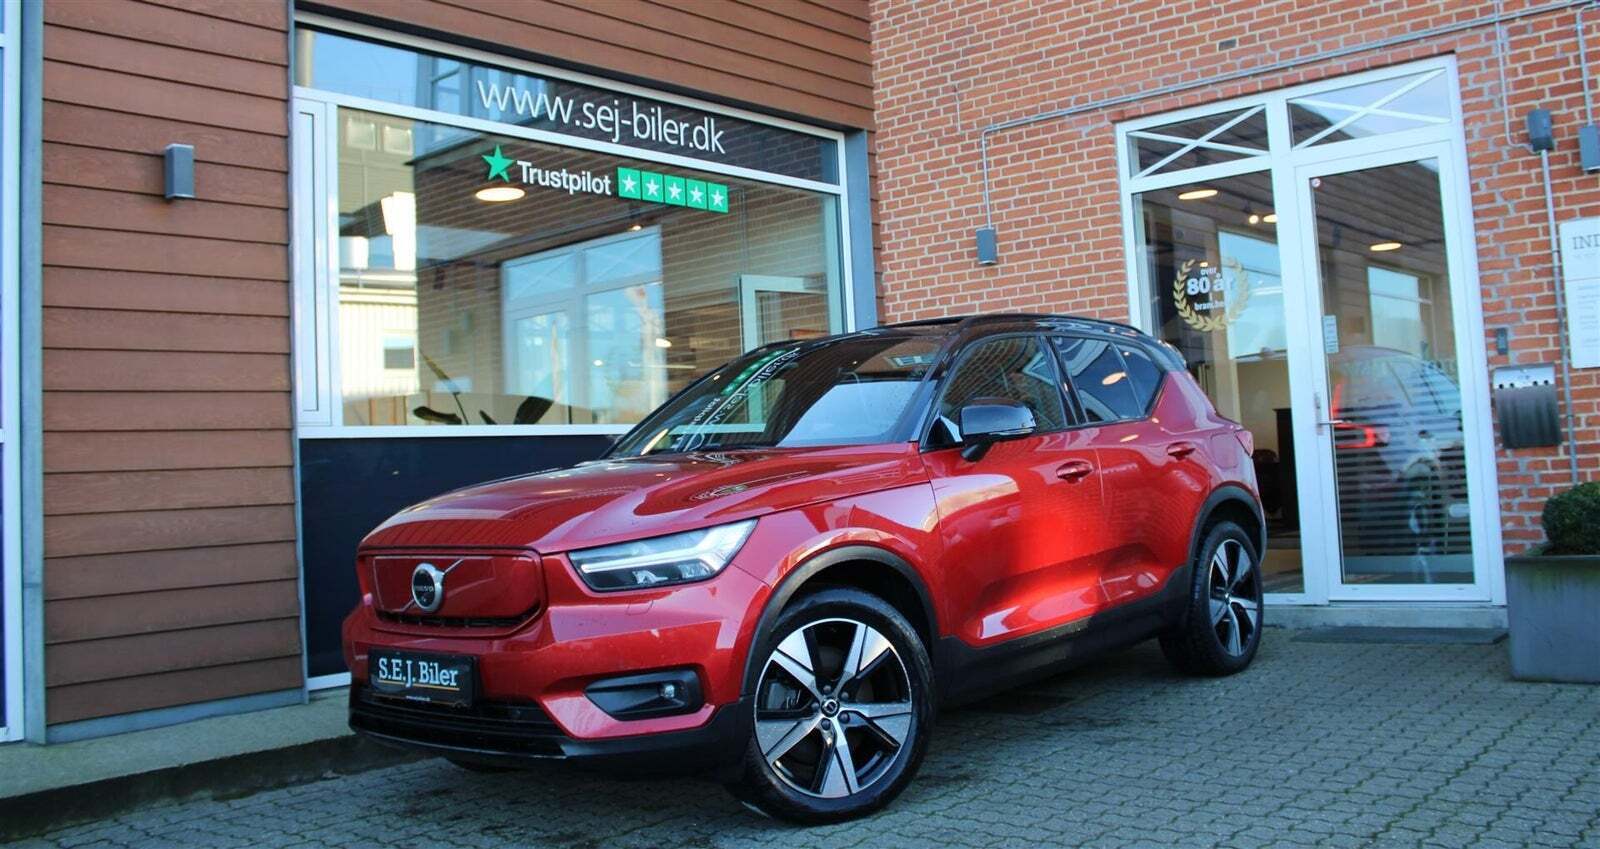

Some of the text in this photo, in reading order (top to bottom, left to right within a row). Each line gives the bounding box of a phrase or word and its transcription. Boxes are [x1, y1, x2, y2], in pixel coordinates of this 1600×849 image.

[477, 79, 726, 154] www.sej-biler.dk
[516, 160, 612, 195] Trustpilot
[1186, 276, 1210, 295] 80
[378, 657, 459, 688] S.E.J. Biler
